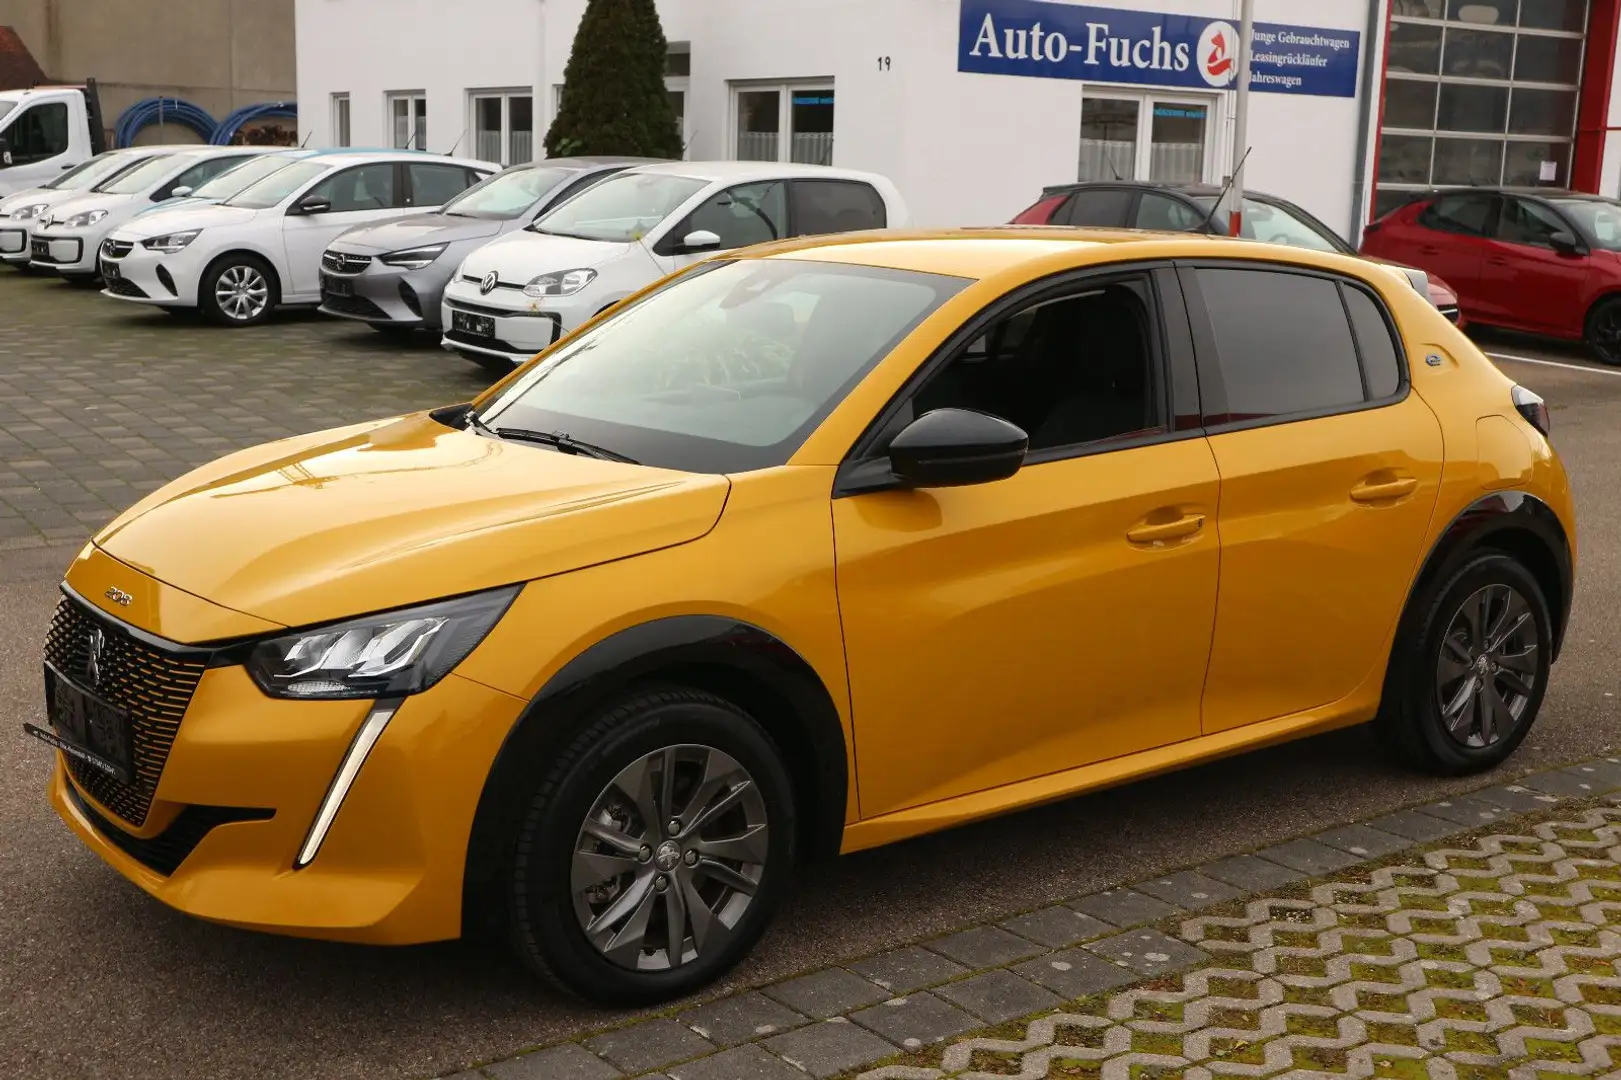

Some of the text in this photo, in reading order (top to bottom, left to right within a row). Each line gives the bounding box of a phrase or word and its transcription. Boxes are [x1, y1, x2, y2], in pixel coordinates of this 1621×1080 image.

[969, 12, 1190, 72] Auto-Fuchs
[1278, 31, 1350, 51] Gebrauchtwagen
[877, 56, 891, 71] 19
[1250, 49, 1328, 67] Leasingrückläufer
